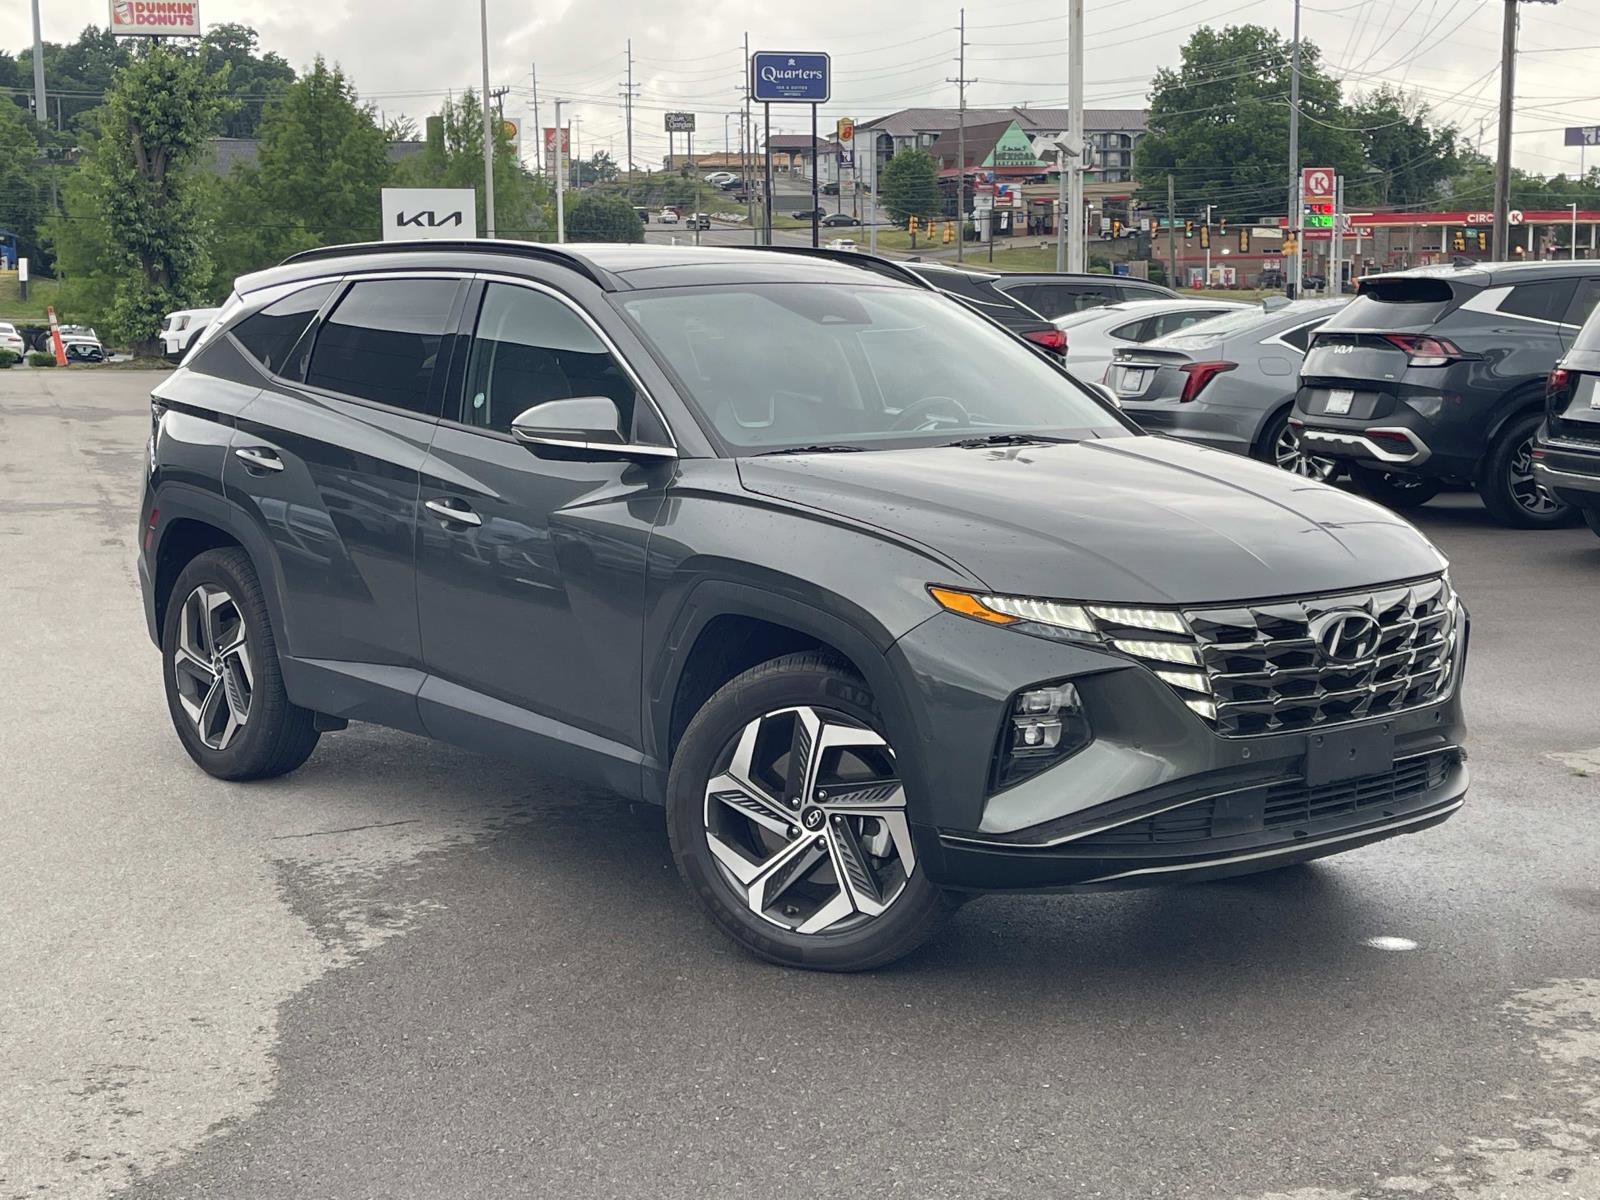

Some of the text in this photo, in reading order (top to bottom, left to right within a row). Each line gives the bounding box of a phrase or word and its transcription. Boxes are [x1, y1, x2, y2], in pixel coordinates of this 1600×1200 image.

[135, 2, 196, 13] DUNKIN'
[135, 14, 194, 25] DONUTS
[761, 66, 823, 83] Quarters
[1312, 175, 1327, 193] K
[397, 211, 462, 228] KIA
[1510, 212, 1522, 225] K
